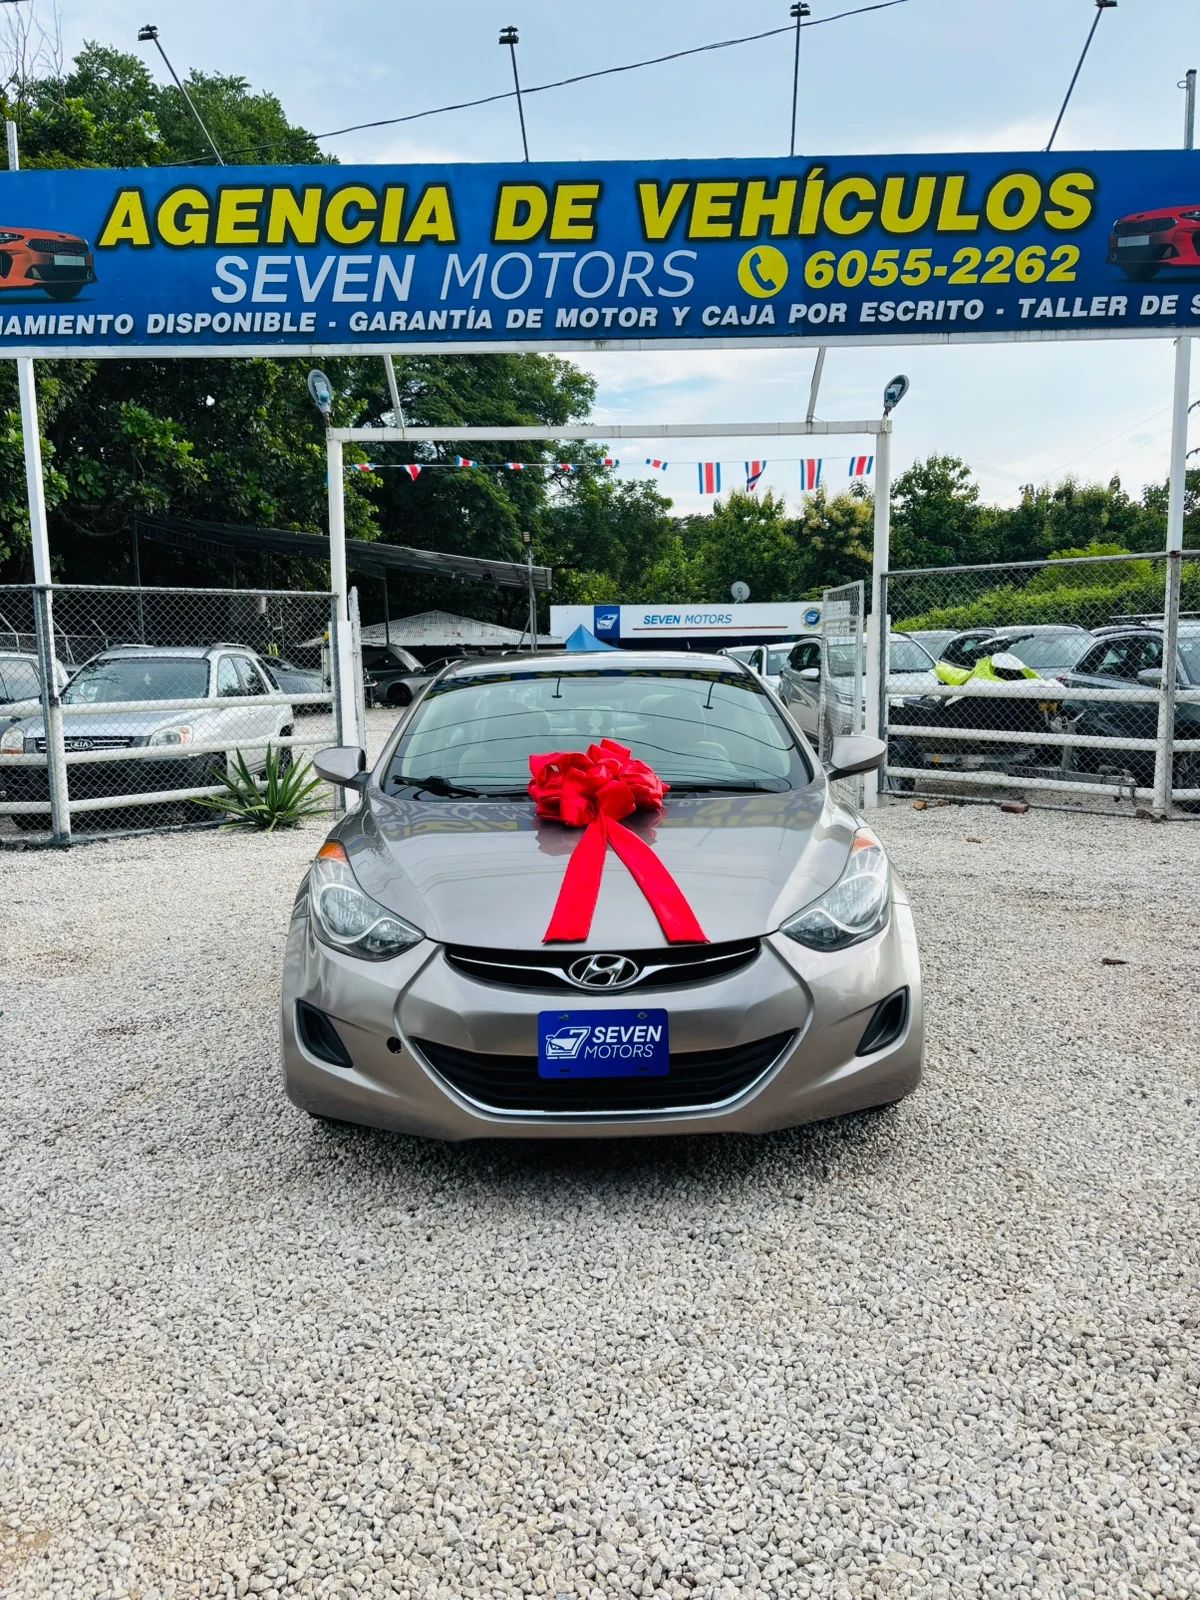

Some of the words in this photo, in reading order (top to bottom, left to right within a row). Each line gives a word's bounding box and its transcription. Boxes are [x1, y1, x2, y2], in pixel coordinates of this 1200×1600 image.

[100, 187, 455, 246] AGENCIA
[494, 184, 600, 241] DE
[639, 168, 1095, 240] VEHÍCULOS
[211, 255, 415, 303] SEVEN
[440, 250, 697, 300] MOTORS
[804, 245, 1080, 289] 6055-2262
[0, 313, 134, 335] AMIENTO
[147, 312, 317, 334] DISPONIBLE
[349, 306, 492, 333] GARANTÍA
[506, 308, 544, 329] DE
[555, 306, 658, 328] MOTOR
[672, 306, 690, 327] Y
[702, 304, 775, 326] CAJA
[789, 303, 847, 325] POR
[859, 299, 984, 323] ESCRITO
[1018, 295, 1128, 319] TALLER
[1140, 294, 1179, 316] DE
[643, 615, 681, 625] SEVEN
[684, 614, 732, 624] MOTORS
[584, 1044, 654, 1059] MOTORS
[592, 1026, 662, 1043] SEVEN
